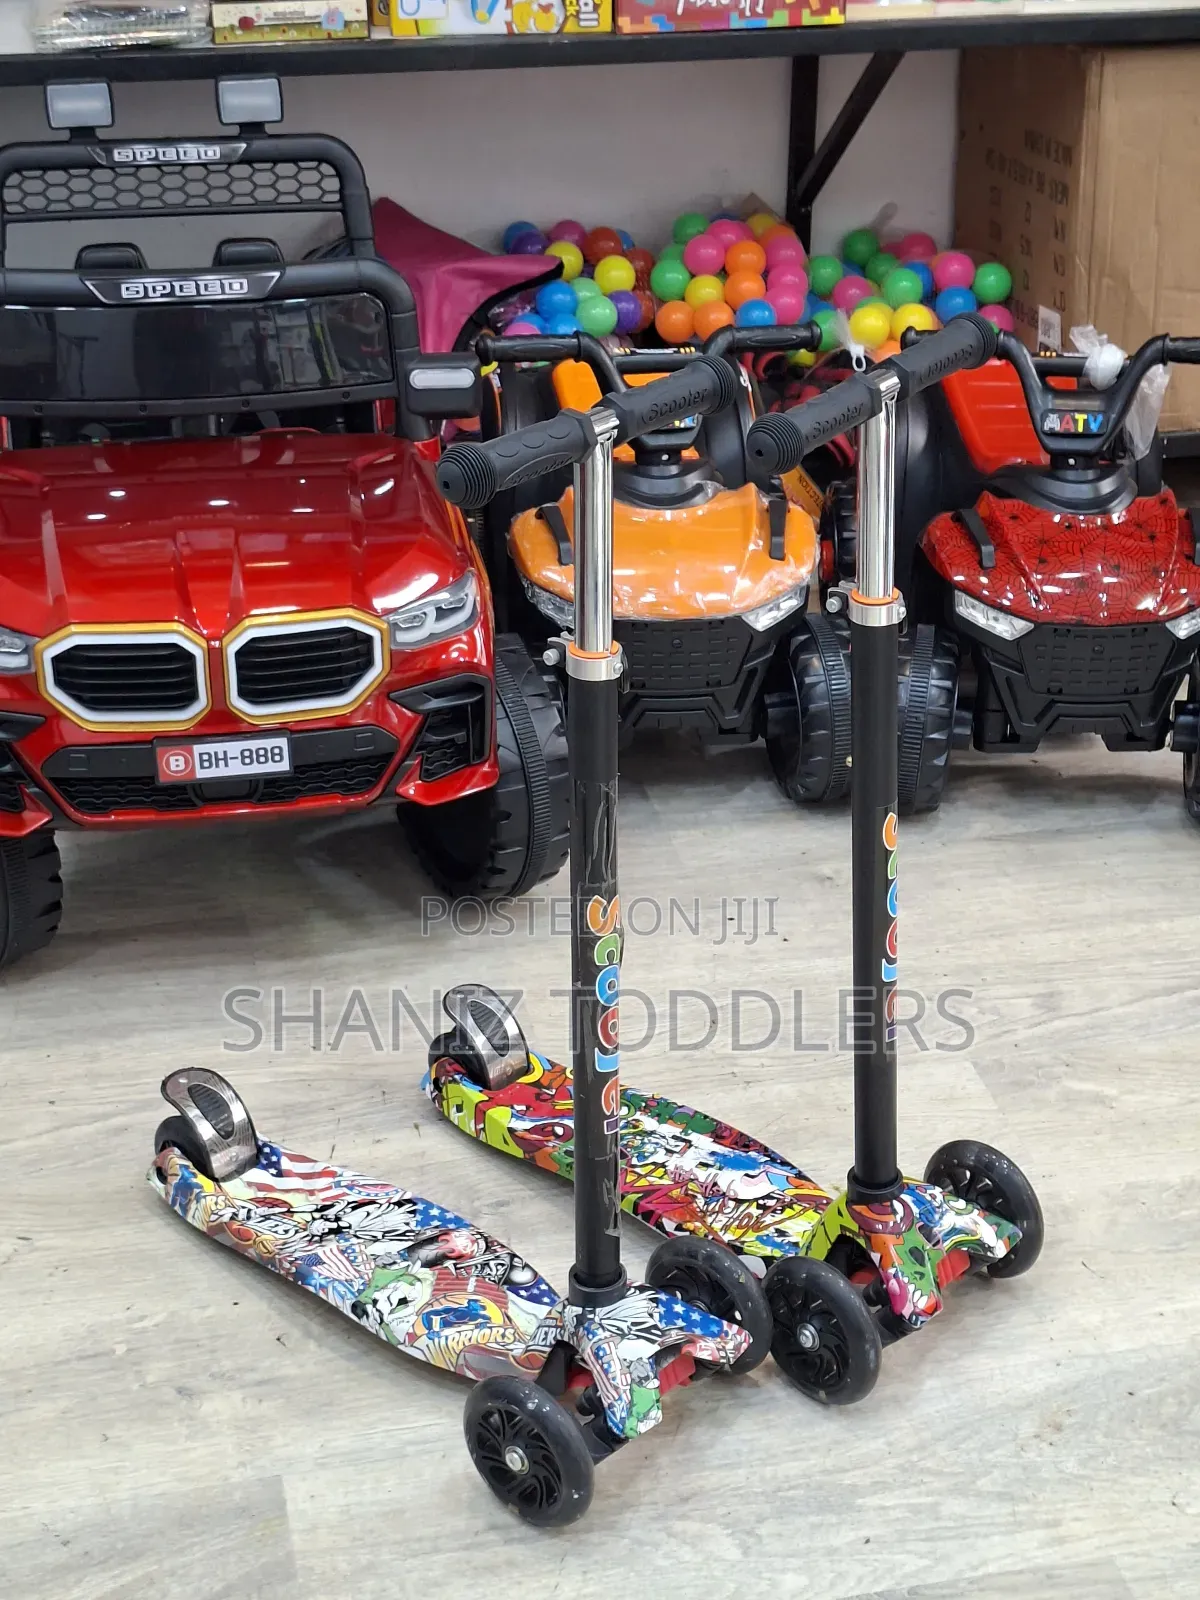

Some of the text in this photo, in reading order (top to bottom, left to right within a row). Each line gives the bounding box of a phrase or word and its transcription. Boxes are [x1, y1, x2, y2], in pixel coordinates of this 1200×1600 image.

[113, 147, 221, 162] SPEED
[121, 278, 248, 299] SPEED
[648, 388, 708, 421] Scooter
[812, 402, 864, 440] Scooter
[198, 745, 285, 770] BH-888
